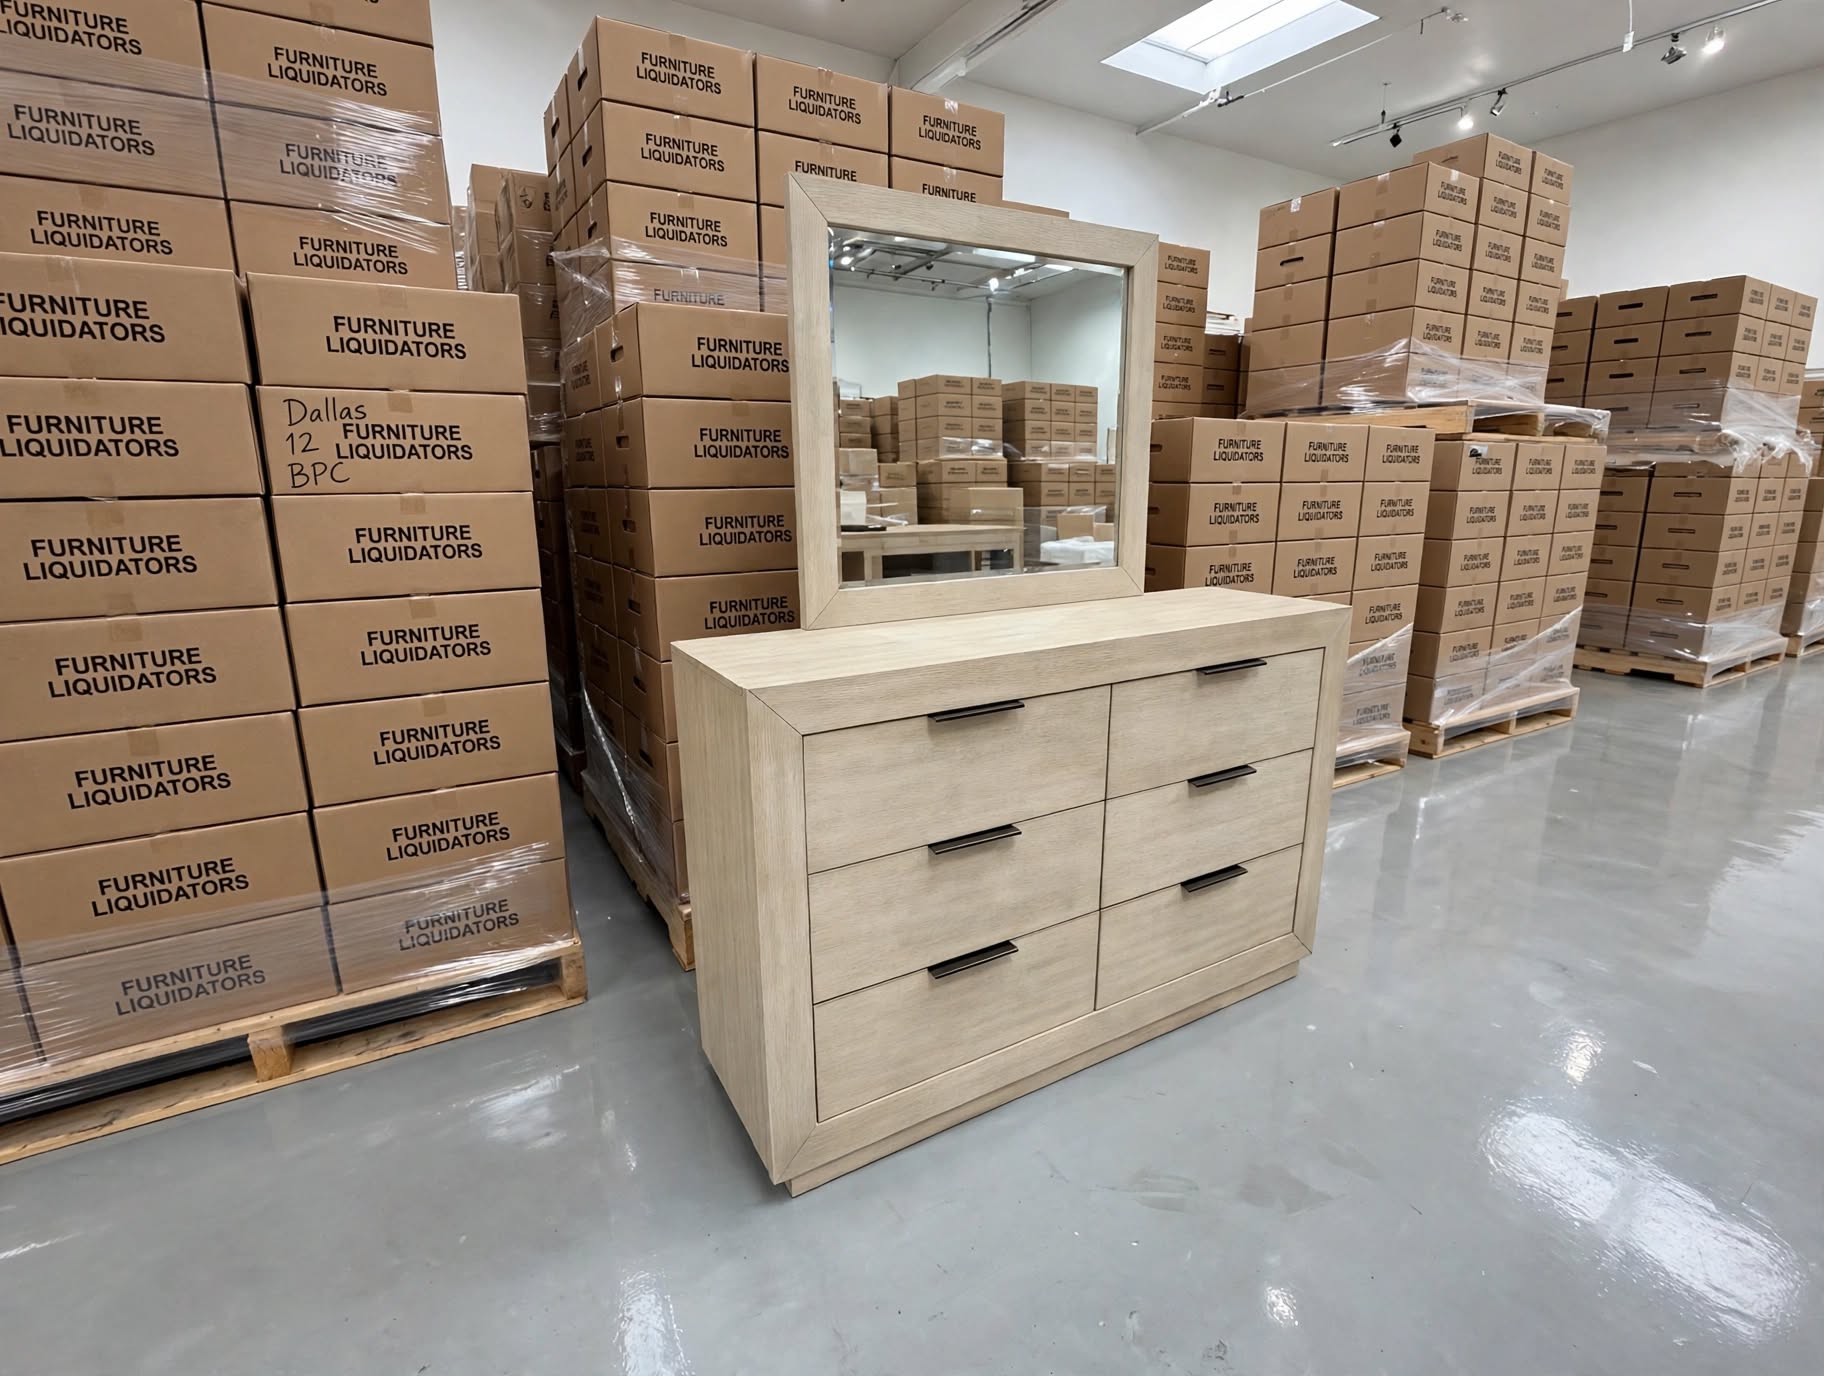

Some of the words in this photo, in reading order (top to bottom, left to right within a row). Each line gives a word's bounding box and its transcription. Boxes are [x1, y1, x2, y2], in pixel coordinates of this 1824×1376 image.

[0, 0, 129, 34] FURNITURE
[273, 46, 378, 79] FURNITURE
[641, 52, 715, 79] FURNITURE
[267, 63, 388, 96] LIQUIDATORS
[636, 66, 722, 95] LIQUIDATORS
[793, 86, 857, 110] FURNITURE
[14, 104, 142, 136] FURNITURE
[788, 98, 861, 125] LIQUIDATORS
[923, 114, 977, 137] FURNITURE
[7, 123, 155, 156] LIQUIDATORS
[645, 133, 718, 157] FURNITURE
[918, 126, 981, 150] LIQUIDATORS
[285, 143, 388, 170] FURNITURE
[641, 147, 725, 172] LIQUIDATORS
[795, 160, 857, 182] FURNITURE
[922, 183, 976, 203] FURNITURE
[37, 210, 160, 237] FURNITURE
[650, 212, 721, 233] FURNITURE
[30, 228, 173, 255] LIQUIDATORS
[645, 225, 728, 247] LIQUIDATORS
[299, 236, 399, 259] FURNITURE
[293, 251, 408, 275] LIQUIDATORS
[1164, 262, 1198, 274] LIQUIDATORS
[1167, 255, 1196, 266] FURNITURE
[654, 288, 725, 305] FURNITURE
[1427, 285, 1457, 298] LIQUIDATORS
[1162, 302, 1196, 313] LIQUIDATORS
[0, 317, 165, 343] IQUIDATORS
[333, 315, 456, 340] FURNITURE
[326, 335, 467, 360] LIQUIDATORS
[697, 336, 783, 356] FURNITURE
[1160, 342, 1193, 352] LIQUIDATORS
[691, 354, 790, 373] LIQUIDATORS
[1158, 381, 1191, 391] LIQUIDATORS
[283, 397, 367, 425] Dallas
[6, 414, 164, 435] FURNITURE
[342, 423, 461, 441] FURNITURE
[285, 432, 319, 455] 12
[700, 428, 782, 443] FURNITURE
[1218, 438, 1262, 449] FURNITURE
[0, 438, 179, 458] LIQUIDATORS
[336, 442, 473, 461] LIQUIDATORS
[694, 445, 789, 459] LIQUIDATORS
[1213, 450, 1264, 462] LIQUIDATORS
[1308, 441, 1347, 452] FURNITURE
[1386, 444, 1419, 454] FURNITURE
[1304, 452, 1349, 463] LIQUIDATORS
[1382, 455, 1420, 464] LIQUIDATORS
[288, 462, 351, 488] BPC
[1472, 467, 1502, 475] LIQUIDATORS
[1214, 502, 1257, 512] FURNITURE
[1302, 500, 1341, 509] FURNITURE
[1376, 508, 1414, 518] LIQUIDATORS
[1380, 499, 1413, 508] FURNITURE
[1469, 506, 1496, 515] FURNITURE
[705, 515, 784, 530] FURNITURE
[1209, 514, 1260, 525] LIQUIDATORS
[1298, 511, 1343, 521] LIQUIDATORS
[1466, 515, 1496, 524] LIQUIDATORS
[355, 525, 472, 544] FURNITURE
[700, 530, 792, 546] LIQUIDATORS
[30, 535, 182, 558] FURNITURE
[348, 542, 483, 564] LIQUIDATORS
[1374, 552, 1407, 562] FURNITURE
[23, 555, 198, 580] LIQUIDATORS
[1297, 557, 1335, 567] FURNITURE
[1371, 561, 1408, 572] LIQUIDATORS
[1460, 561, 1491, 571] LIQUIDATORS
[1463, 553, 1490, 562] FURNITURE
[1209, 562, 1252, 575] FURNITURE
[1293, 567, 1337, 578] LIQUIDATORS
[1205, 574, 1254, 587] LIQUIDATORS
[710, 596, 788, 614] FURNITURE
[1368, 603, 1401, 614] FURNITURE
[1454, 606, 1485, 617] LIQUIDATORS
[705, 610, 795, 630] LIQUIDATORS
[1365, 612, 1402, 625] LIQUIDATORS
[366, 624, 480, 647] FURNITURE
[55, 647, 203, 676] FURNITURE
[361, 641, 492, 666] LIQUIDATORS
[48, 666, 217, 698] LIQUIDATORS
[379, 719, 490, 747] FURNITURE
[373, 736, 501, 765] LIQUIDATORS
[75, 754, 217, 787] FURNITURE
[67, 772, 232, 809] LIQUIDATORS
[392, 811, 500, 843] FURNITURE
[387, 828, 510, 861] LIQUIDATORS
[98, 857, 236, 896] FURNITURE
[92, 874, 249, 917] LIQUIDATORS
[405, 899, 510, 934] FURNITURE
[399, 912, 520, 951] LIQUIDATORS
[121, 955, 253, 997] FURNITURE
[115, 970, 266, 1016] LIQUIDATORS
